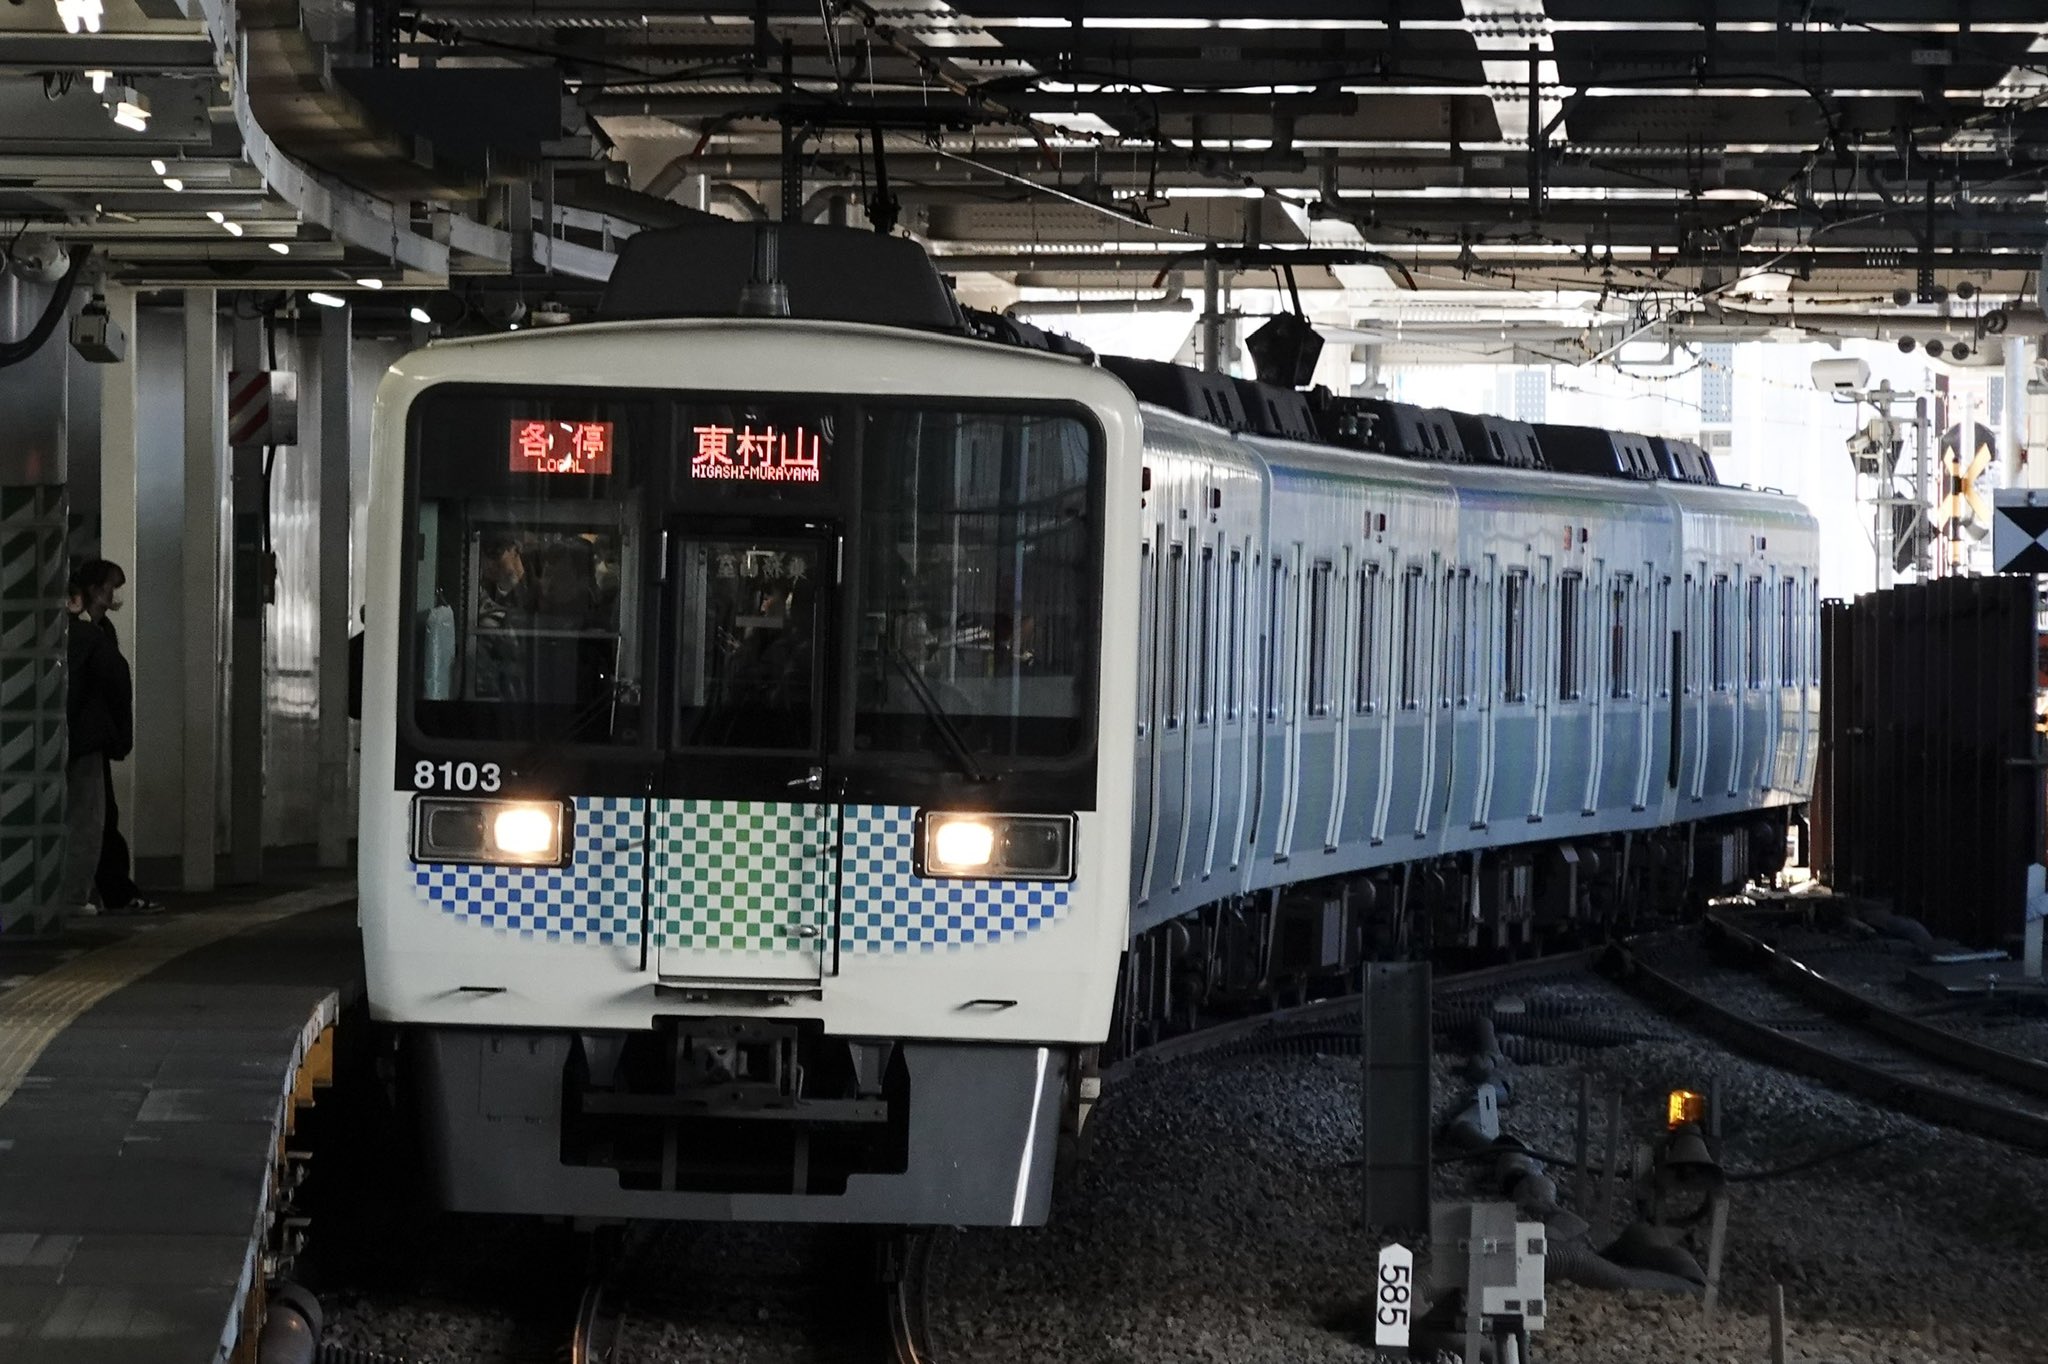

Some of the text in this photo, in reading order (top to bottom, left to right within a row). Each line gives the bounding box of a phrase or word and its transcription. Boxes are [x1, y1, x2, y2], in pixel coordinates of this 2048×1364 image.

[519, 422, 604, 460] 各停
[692, 424, 819, 468] 東村山
[692, 464, 819, 482] HIGASHI-MURAYAMA
[414, 760, 501, 792] 8103
[1378, 1264, 1410, 1326] 585
